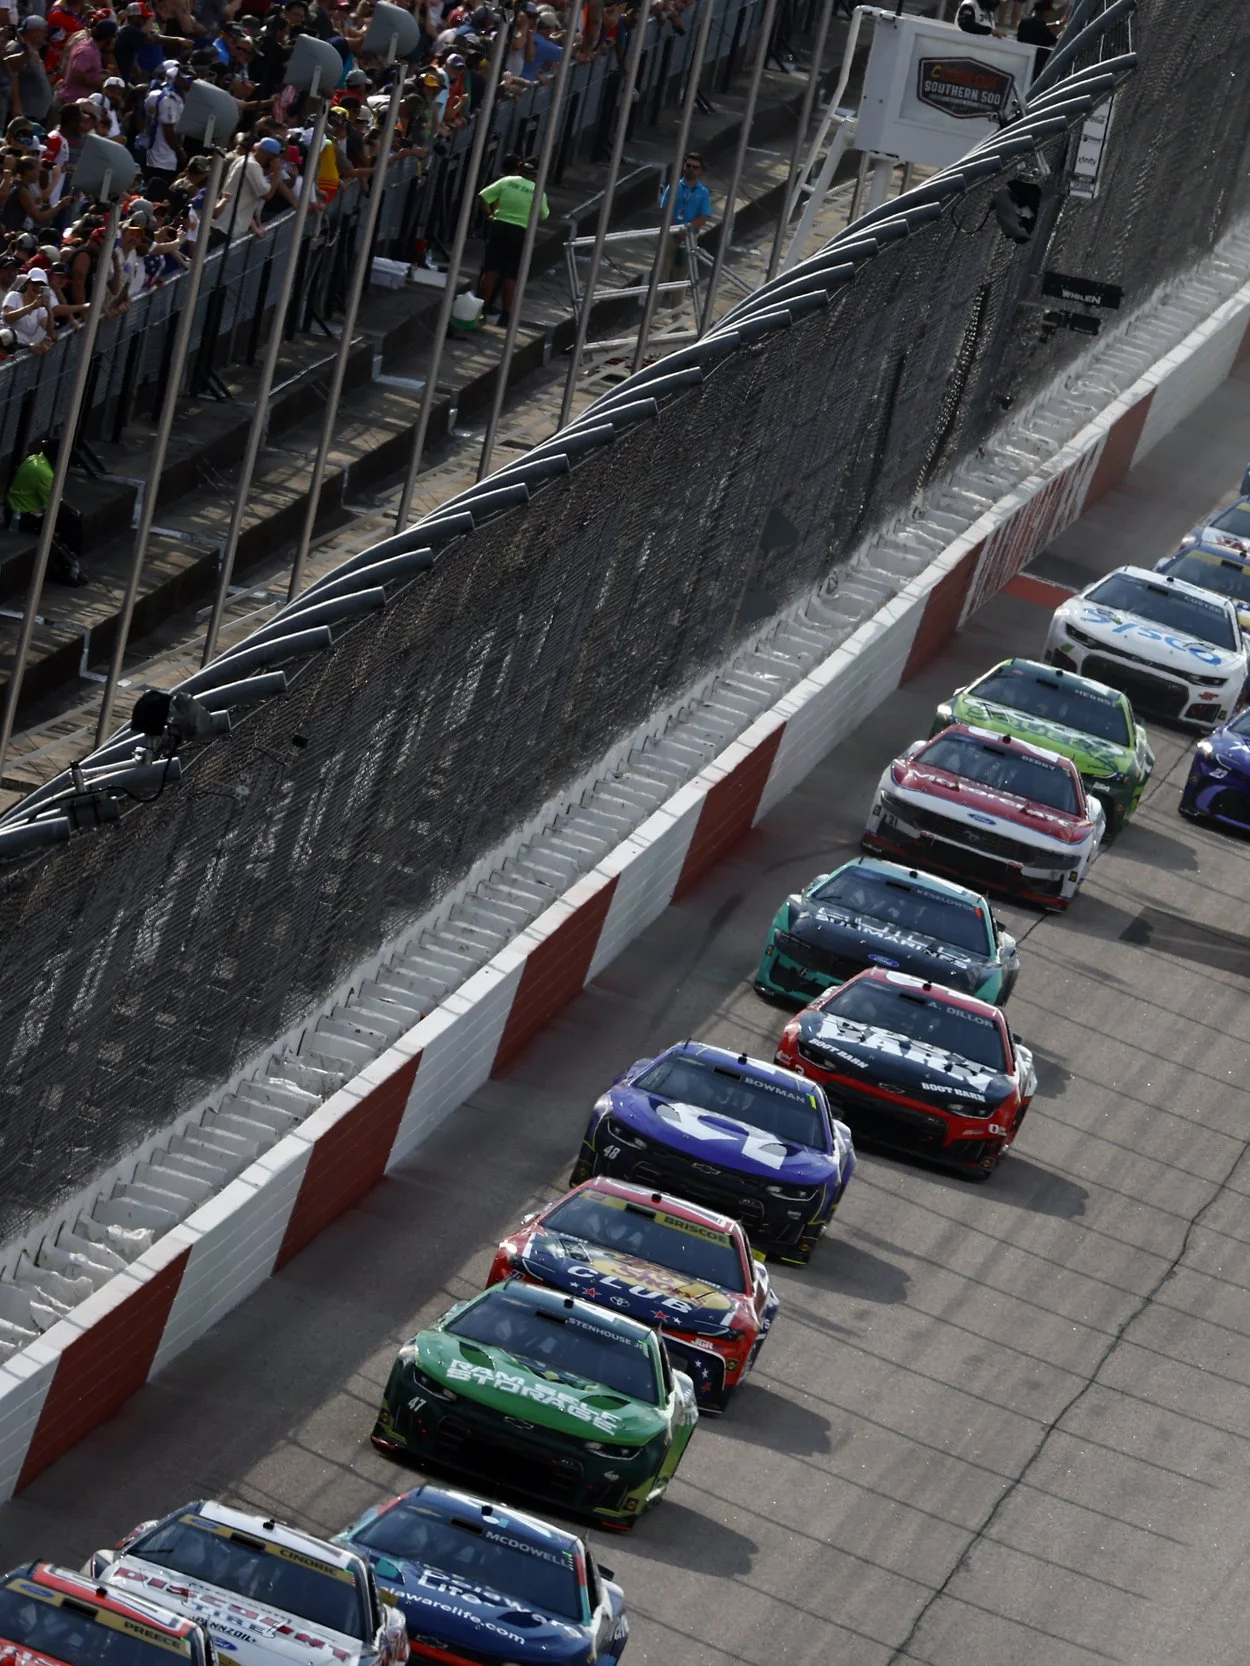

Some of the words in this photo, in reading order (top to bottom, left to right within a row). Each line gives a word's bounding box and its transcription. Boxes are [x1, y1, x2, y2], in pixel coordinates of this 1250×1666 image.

[924, 80, 979, 102] SOUTHERN
[980, 91, 1001, 105] 500
[927, 1001, 942, 1011] A.
[946, 1006, 995, 1029] DILLON
[807, 1038, 838, 1055] BOOT
[838, 1049, 869, 1069] BARN
[742, 1075, 807, 1105] BOWMAN
[921, 1081, 952, 1094] BOOT
[954, 1085, 986, 1103] BARN
[602, 1144, 621, 1161] 48
[664, 1215, 730, 1245] BRISCOE
[566, 1265, 694, 1314] CLUB
[566, 1317, 634, 1347] STENHOUSE
[406, 1396, 427, 1412] 47
[446, 1367, 618, 1436] STORAGE
[280, 1548, 338, 1576] CINDRIC
[485, 1530, 569, 1568] MCDOWELL
[114, 1566, 350, 1662] DISCOUNT
[195, 1603, 268, 1635] TIRE
[123, 1620, 181, 1650] PREECE
